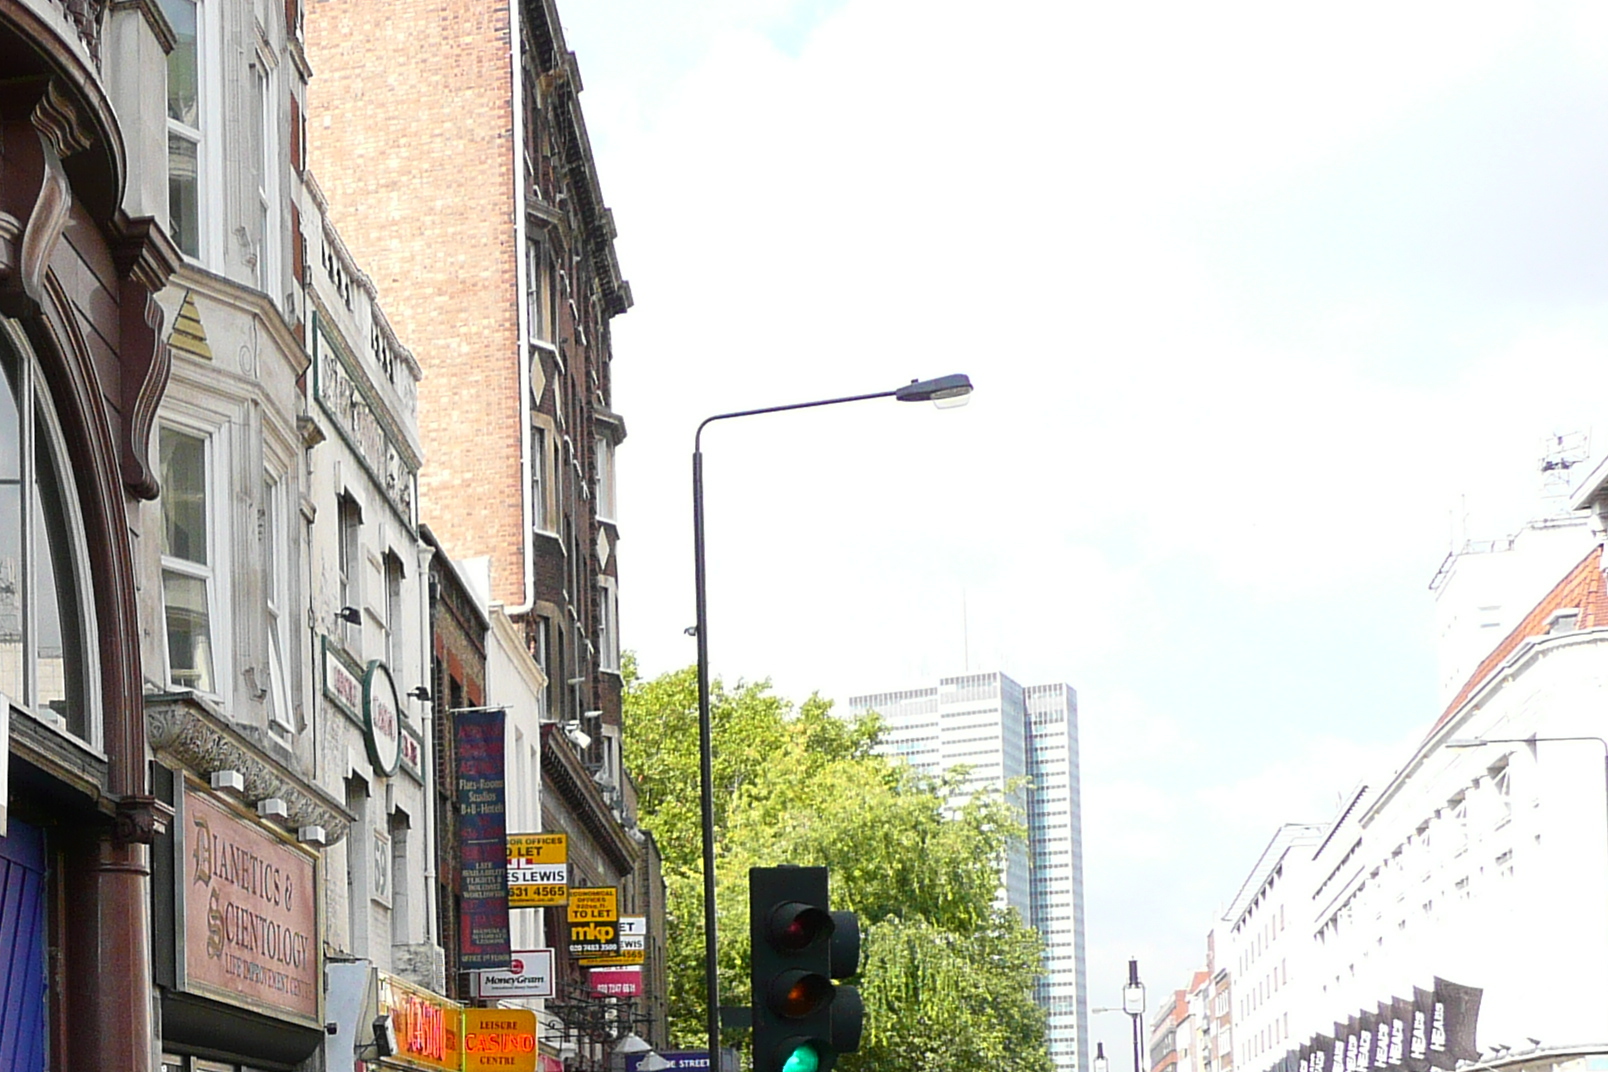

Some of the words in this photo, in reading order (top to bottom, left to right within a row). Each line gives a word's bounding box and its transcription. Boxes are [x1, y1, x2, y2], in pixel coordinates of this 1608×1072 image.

[518, 846, 543, 857] LET
[192, 812, 280, 907] DIANETICS
[523, 870, 565, 882] LEWIS
[533, 886, 565, 896] 4565
[573, 910, 588, 918] TO
[591, 909, 612, 918] LET
[206, 885, 309, 972] SCIENTOLOGY
[571, 922, 615, 943] mkp
[479, 1020, 518, 1030] LEISURE
[465, 1033, 536, 1053] CASINO
[479, 1055, 516, 1065] CENTRE
[678, 1058, 710, 1068] STREET
